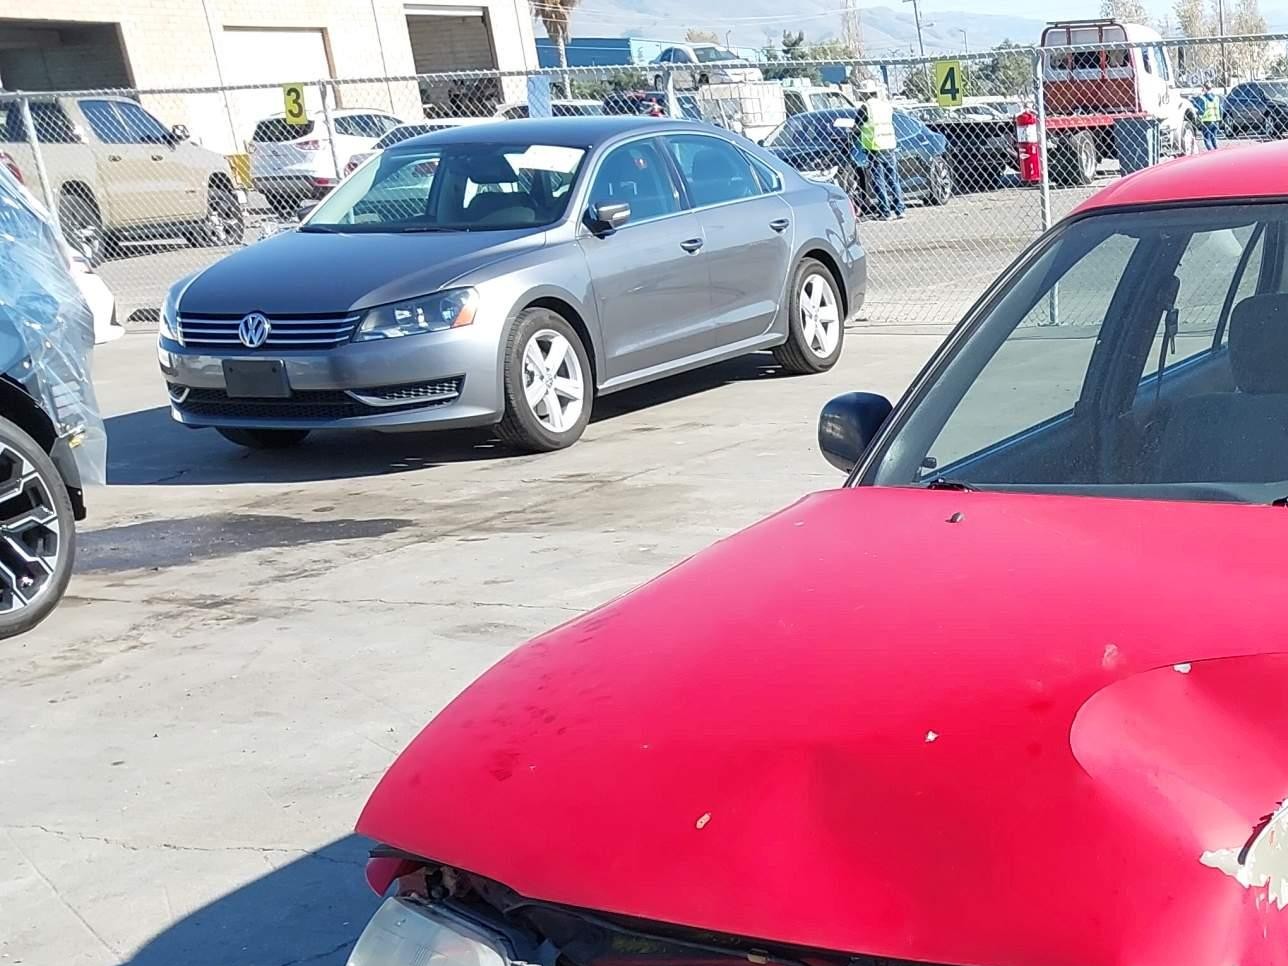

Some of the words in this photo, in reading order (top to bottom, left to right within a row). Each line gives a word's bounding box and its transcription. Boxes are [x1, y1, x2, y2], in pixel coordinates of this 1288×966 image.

[940, 66, 960, 101] 4
[286, 87, 304, 118] 3
[239, 312, 269, 348] VW
